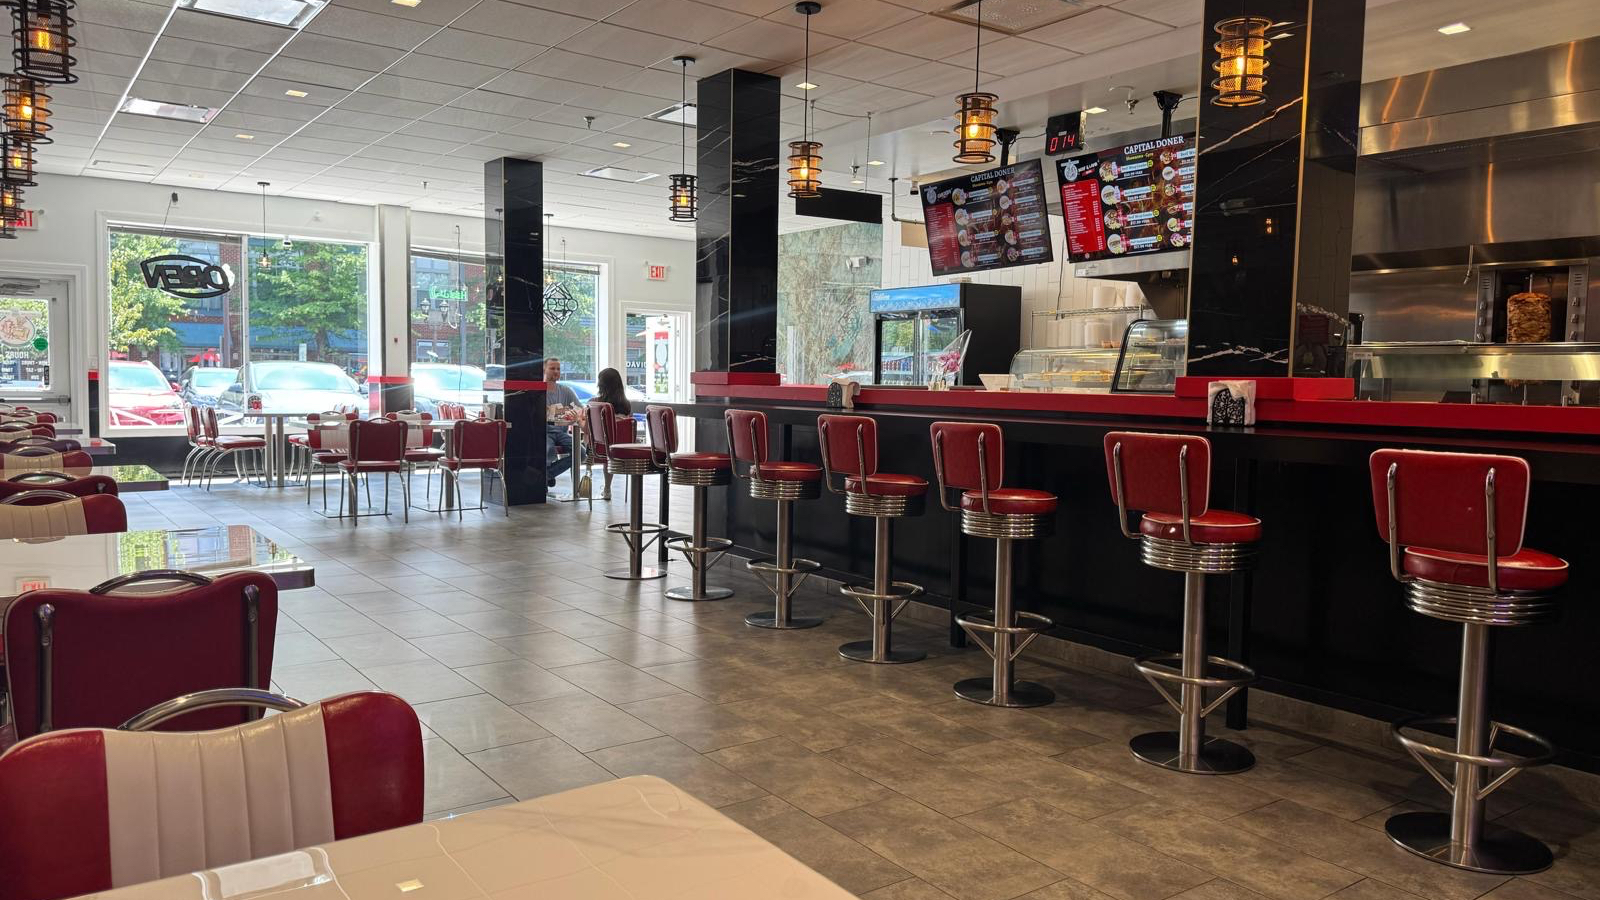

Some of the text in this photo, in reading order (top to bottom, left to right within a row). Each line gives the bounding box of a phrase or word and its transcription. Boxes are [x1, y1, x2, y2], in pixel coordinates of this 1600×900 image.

[1124, 135, 1185, 155] CAPITAL DONER
[970, 166, 1015, 182] CAPITAL DONER
[650, 265, 665, 279] EXIT
